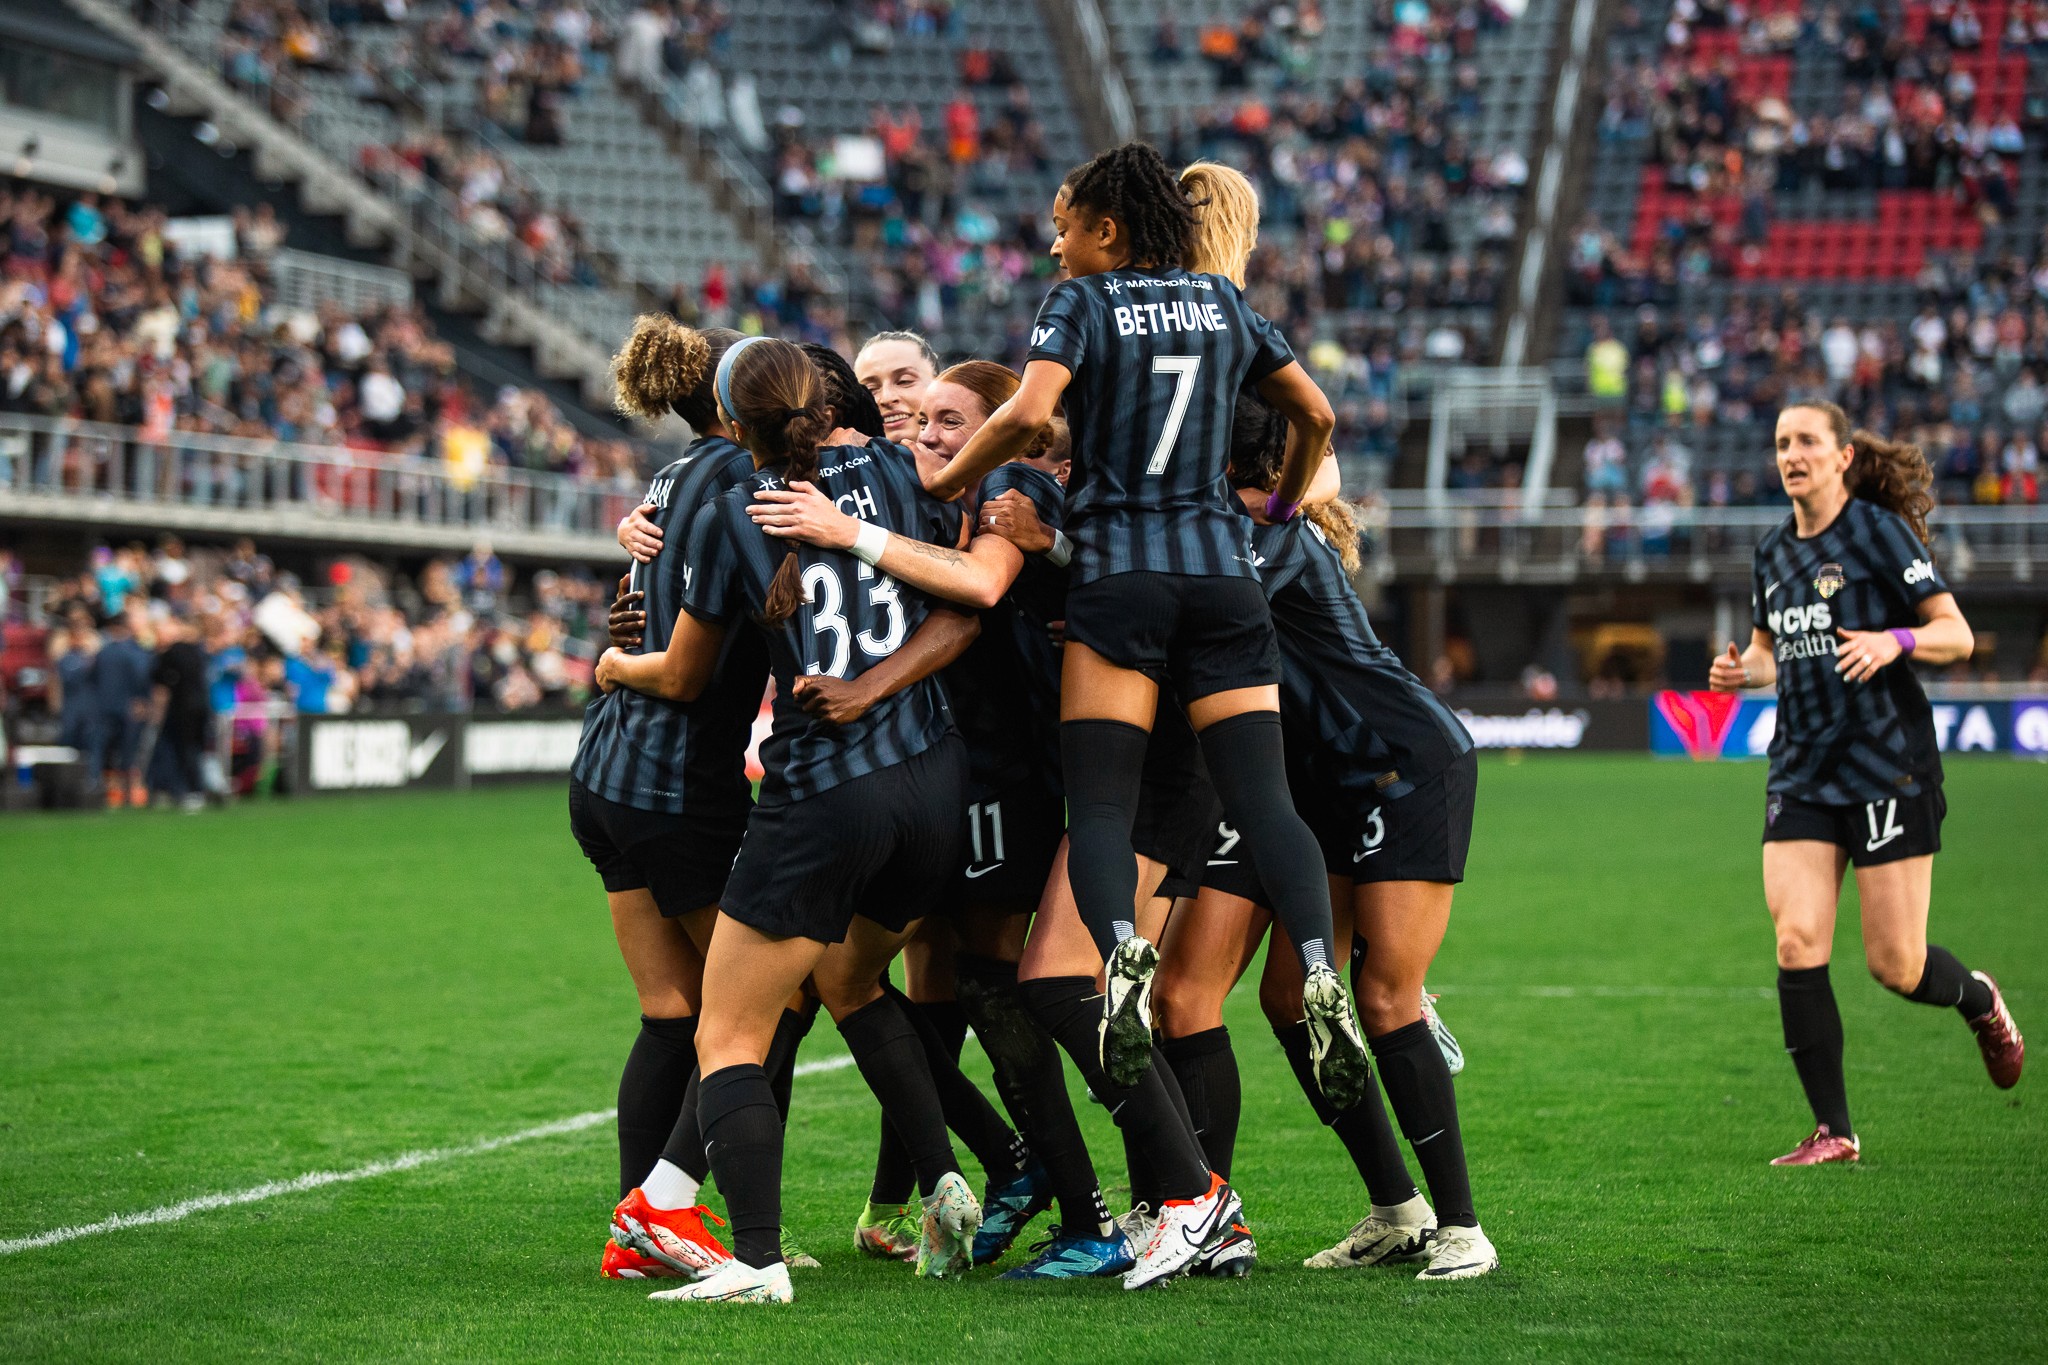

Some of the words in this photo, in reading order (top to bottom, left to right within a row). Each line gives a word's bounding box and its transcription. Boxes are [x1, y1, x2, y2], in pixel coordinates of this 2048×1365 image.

[1113, 301, 1227, 336] BETHUNE
[1146, 355, 1201, 475] 7
[800, 562, 907, 679] 33
[1783, 602, 1832, 635] CVS
[968, 801, 1005, 862] 11
[1362, 805, 1386, 849] 3
